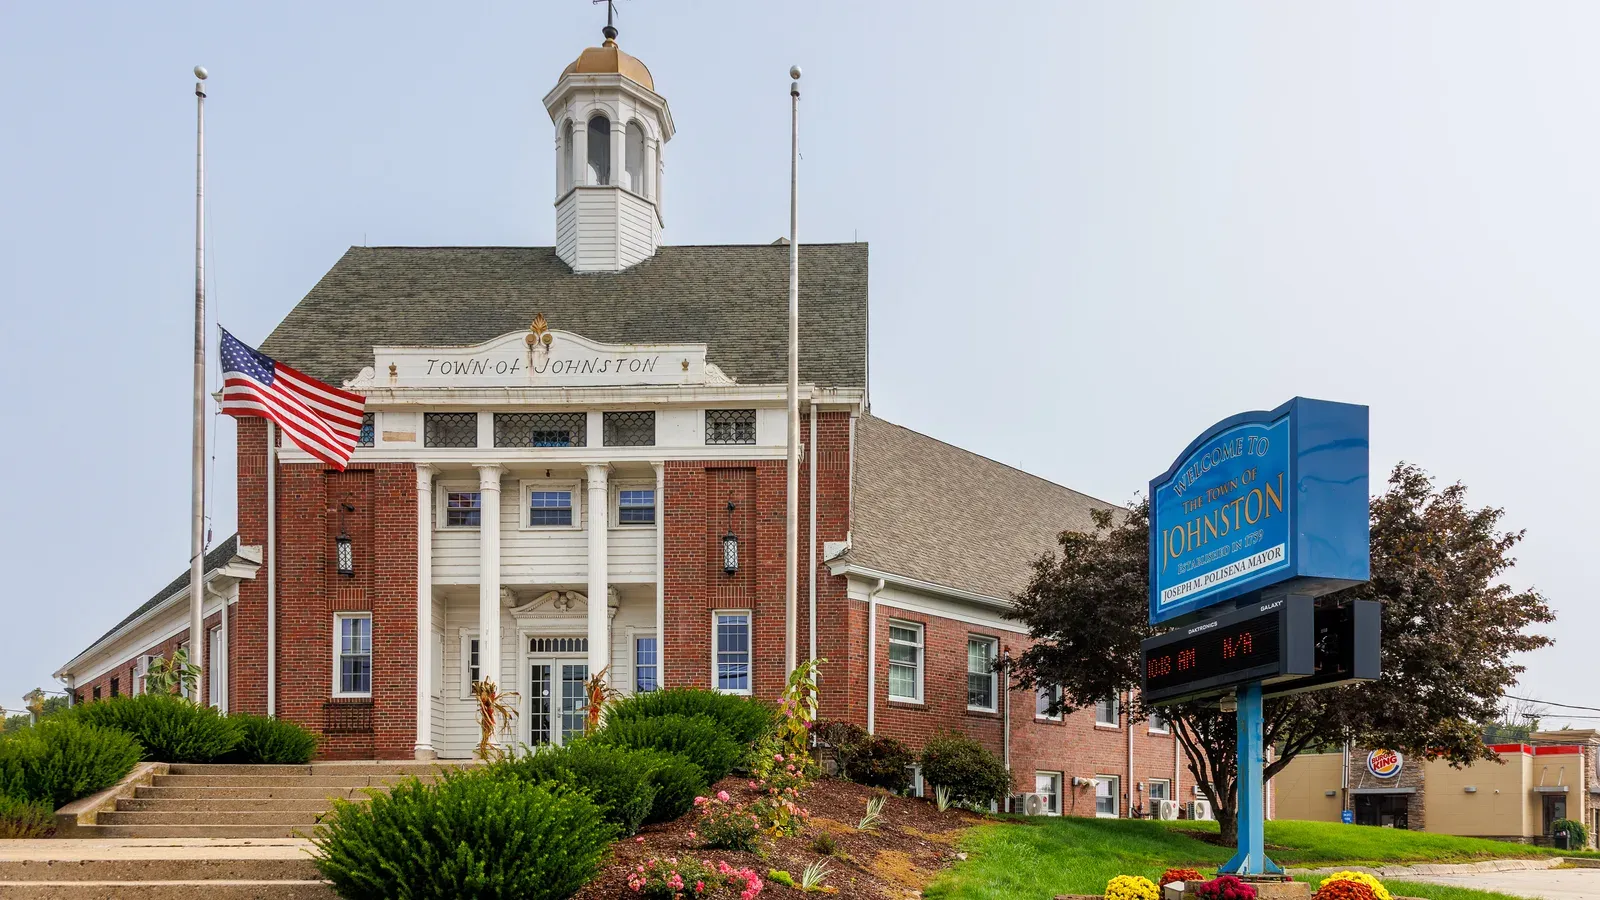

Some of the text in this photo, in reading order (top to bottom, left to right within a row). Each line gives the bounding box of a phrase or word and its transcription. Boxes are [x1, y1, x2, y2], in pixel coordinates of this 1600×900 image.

[426, 358, 491, 375] TOWN
[534, 356, 659, 375] JOHNSTON
[1173, 435, 1270, 498] WELCOME TO
[1183, 496, 1203, 515] THE
[1206, 477, 1238, 504] TOWN
[1161, 471, 1285, 574] JOHNSTON
[1231, 539, 1243, 553] IN
[1244, 529, 1265, 548] 1759
[1163, 547, 1282, 602] JOSEPH M. POLISENA MAYOR
[1188, 620, 1218, 635] DAKTRONICS
[1178, 647, 1195, 671] AM
[1373, 755, 1398, 771] KING
